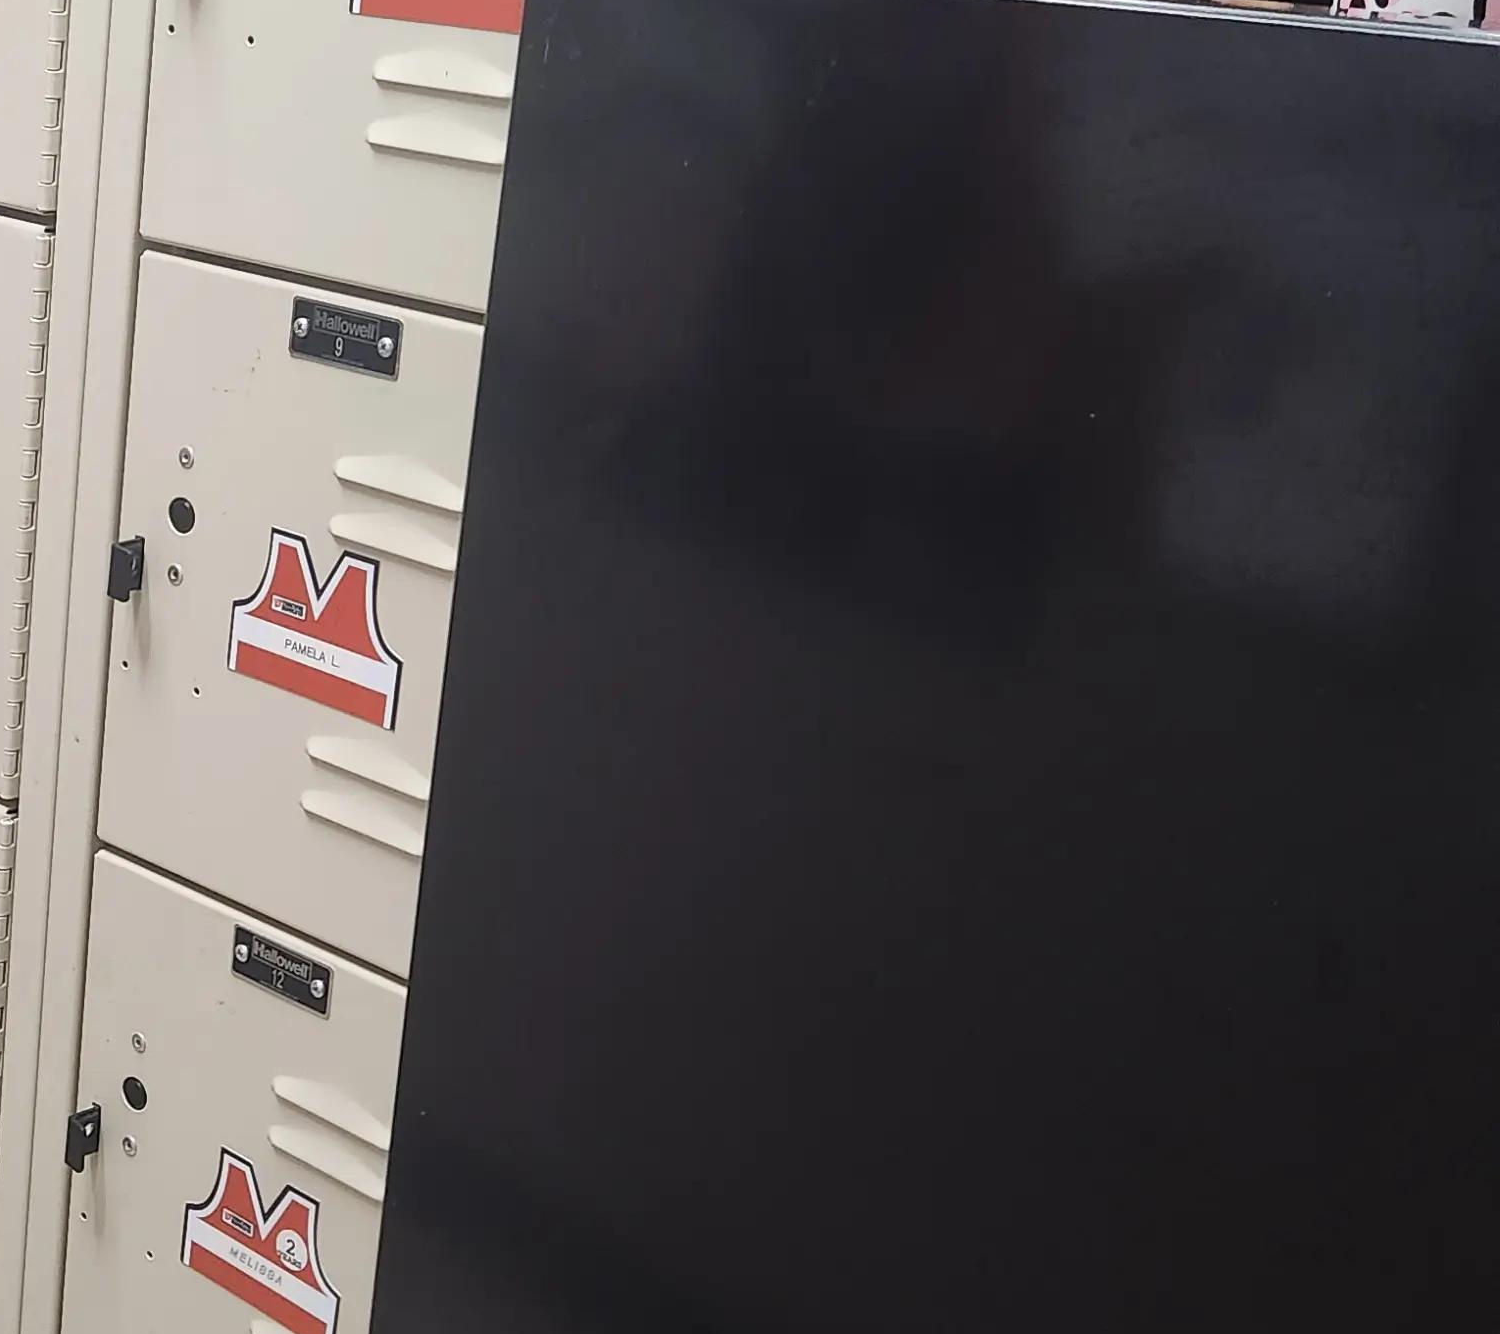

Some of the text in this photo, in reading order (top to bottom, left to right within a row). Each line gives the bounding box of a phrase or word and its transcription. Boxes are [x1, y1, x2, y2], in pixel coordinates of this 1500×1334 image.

[315, 307, 376, 340] Hallowell
[334, 337, 343, 357] 9
[284, 638, 326, 663] PAMELA
[253, 942, 309, 979] Hallowell
[270, 969, 285, 990] 12
[286, 1239, 296, 1257] 2
[229, 1246, 283, 1287] MELISSA
